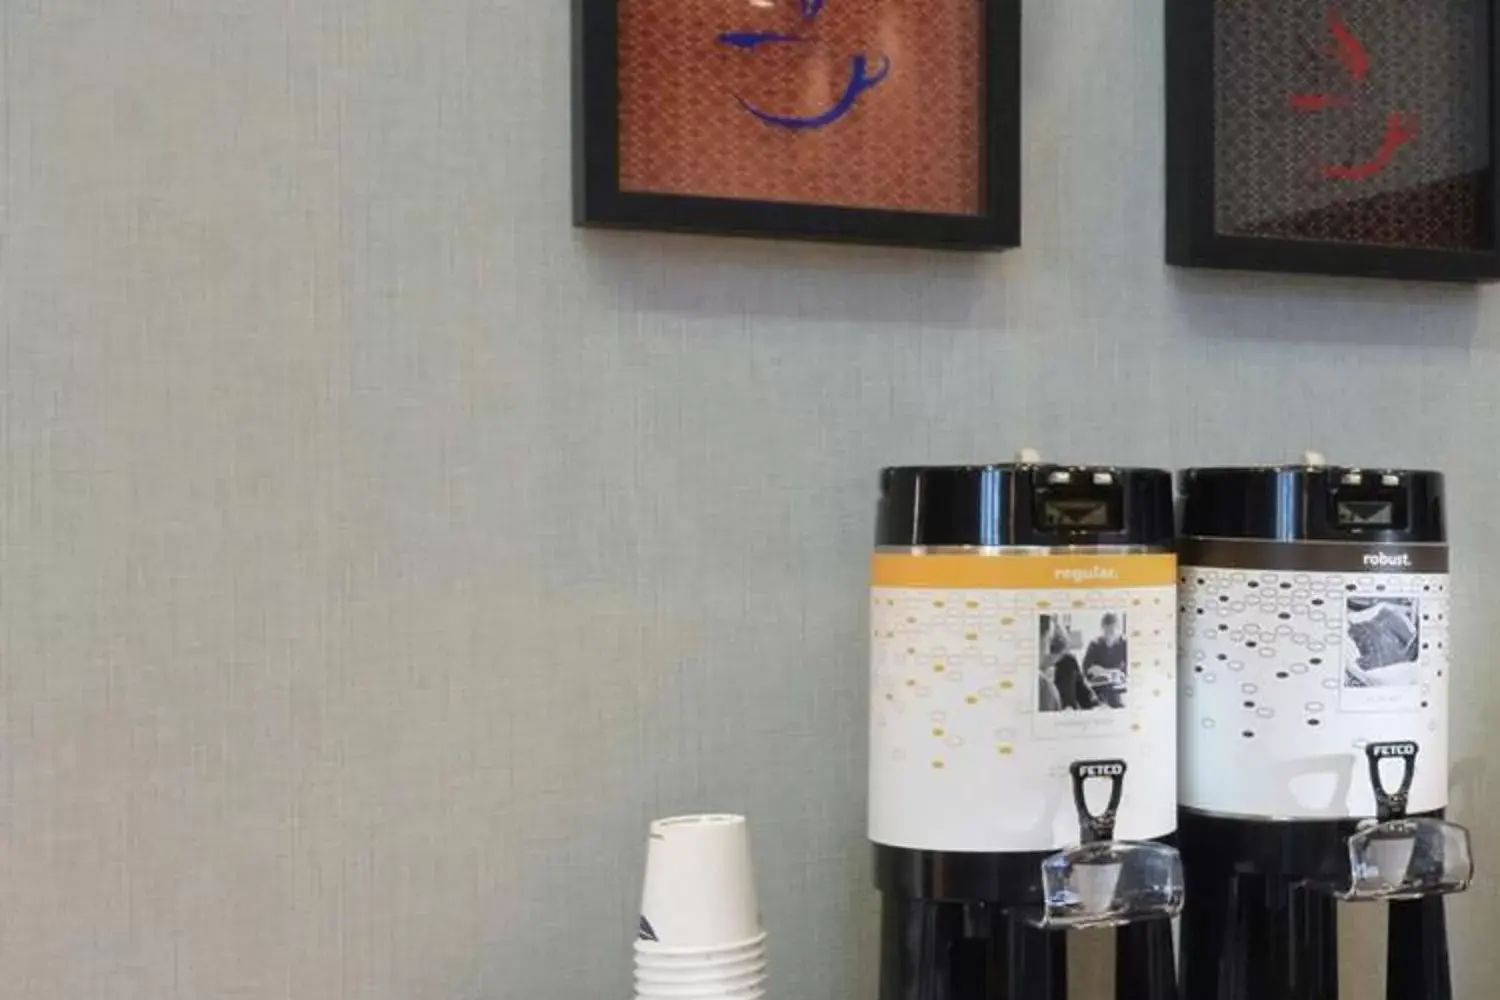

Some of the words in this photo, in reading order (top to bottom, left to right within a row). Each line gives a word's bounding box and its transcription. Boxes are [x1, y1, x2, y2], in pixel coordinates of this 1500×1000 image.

[1363, 551, 1413, 566] robust.
[1373, 744, 1414, 756] FETCO
[1079, 764, 1121, 777] FETCO
